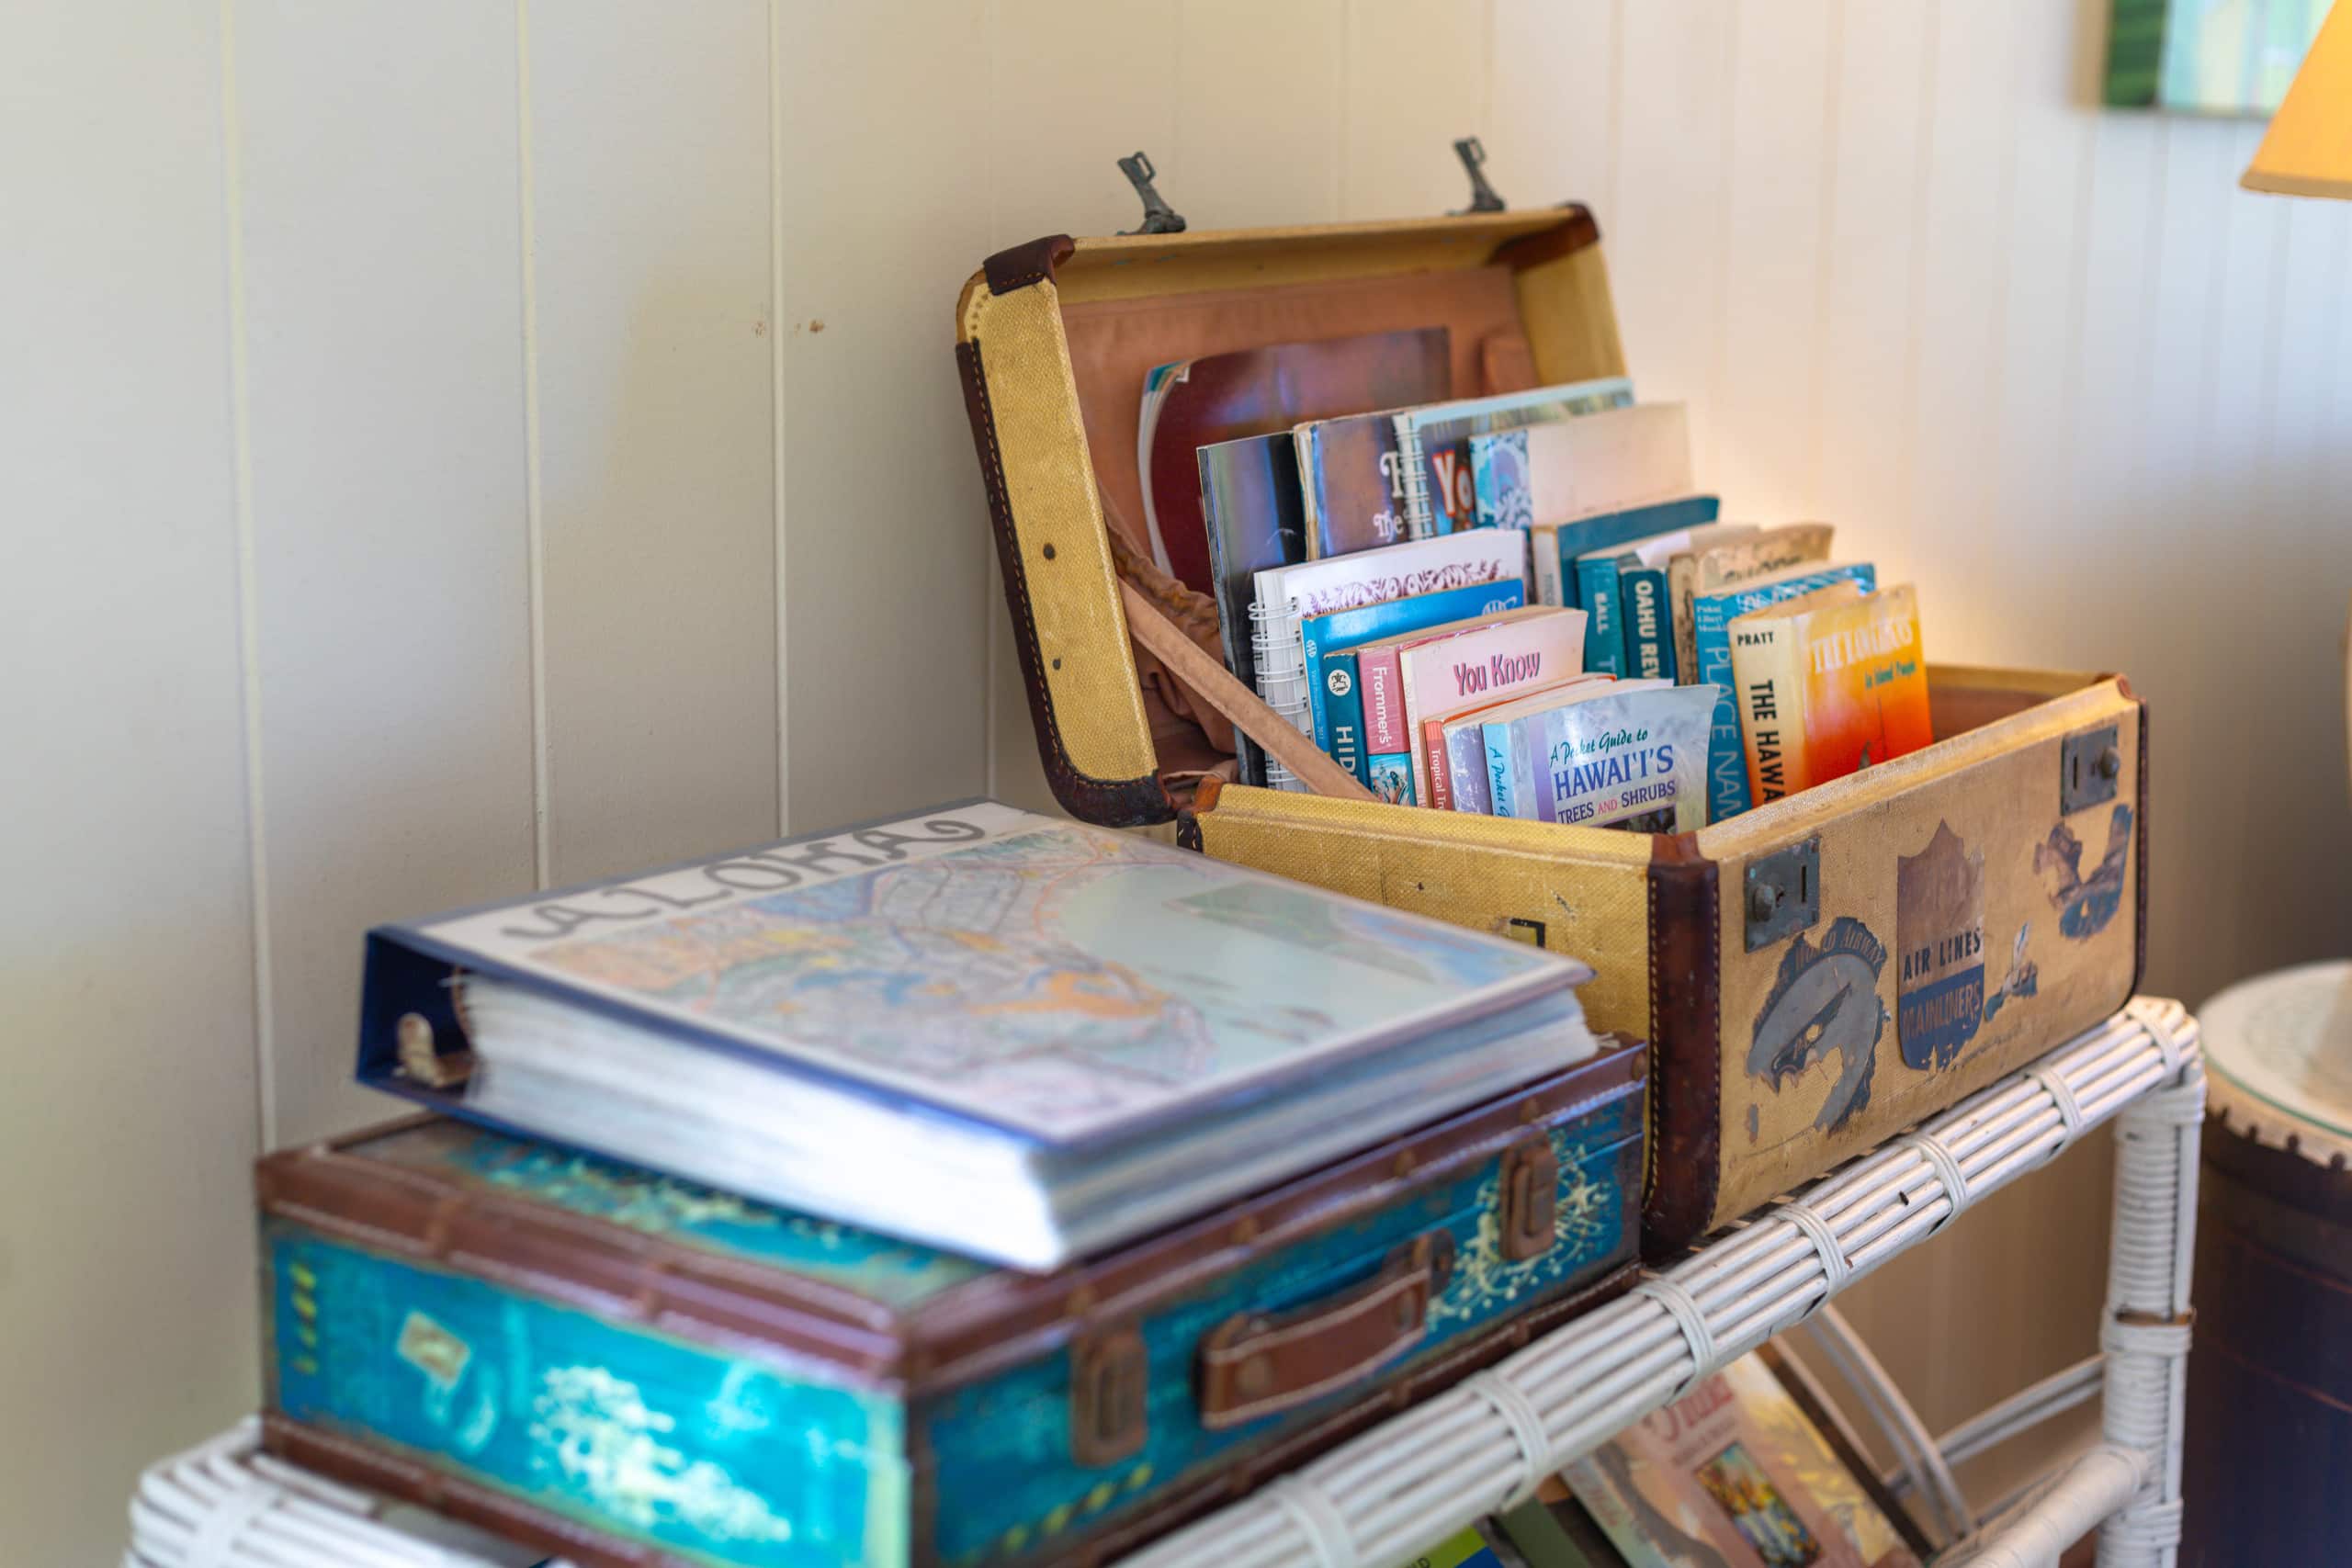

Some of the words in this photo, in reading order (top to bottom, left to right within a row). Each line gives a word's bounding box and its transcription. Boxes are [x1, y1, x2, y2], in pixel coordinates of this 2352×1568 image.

[1634, 580, 1657, 638] OAHU
[1736, 631, 1774, 647] PRATT
[1453, 661, 1488, 697] You
[1489, 651, 1542, 688] Know
[1705, 646, 1738, 740] PLACE
[1372, 665, 1392, 745] Frommer's
[1749, 679, 1778, 721] THE
[1335, 726, 1358, 779] HID
[1430, 749, 1446, 793] Tropical
[1488, 746, 1504, 759] A
[1549, 742, 1559, 769] A
[1560, 738, 1596, 765] Poket
[1598, 728, 1633, 755] Guide
[1635, 728, 1648, 742] to
[1756, 730, 1788, 805] HAWA
[1491, 761, 1508, 802] Pocket
[1557, 801, 1595, 824] TREES
[1597, 798, 1618, 815] AND
[1621, 779, 1677, 808] SHRUBS
[500, 819, 986, 941] ALOHA
[1903, 946, 1930, 982] AIR
[1939, 926, 1982, 968] LINES
[1903, 979, 1982, 1043] MAINLINERS
